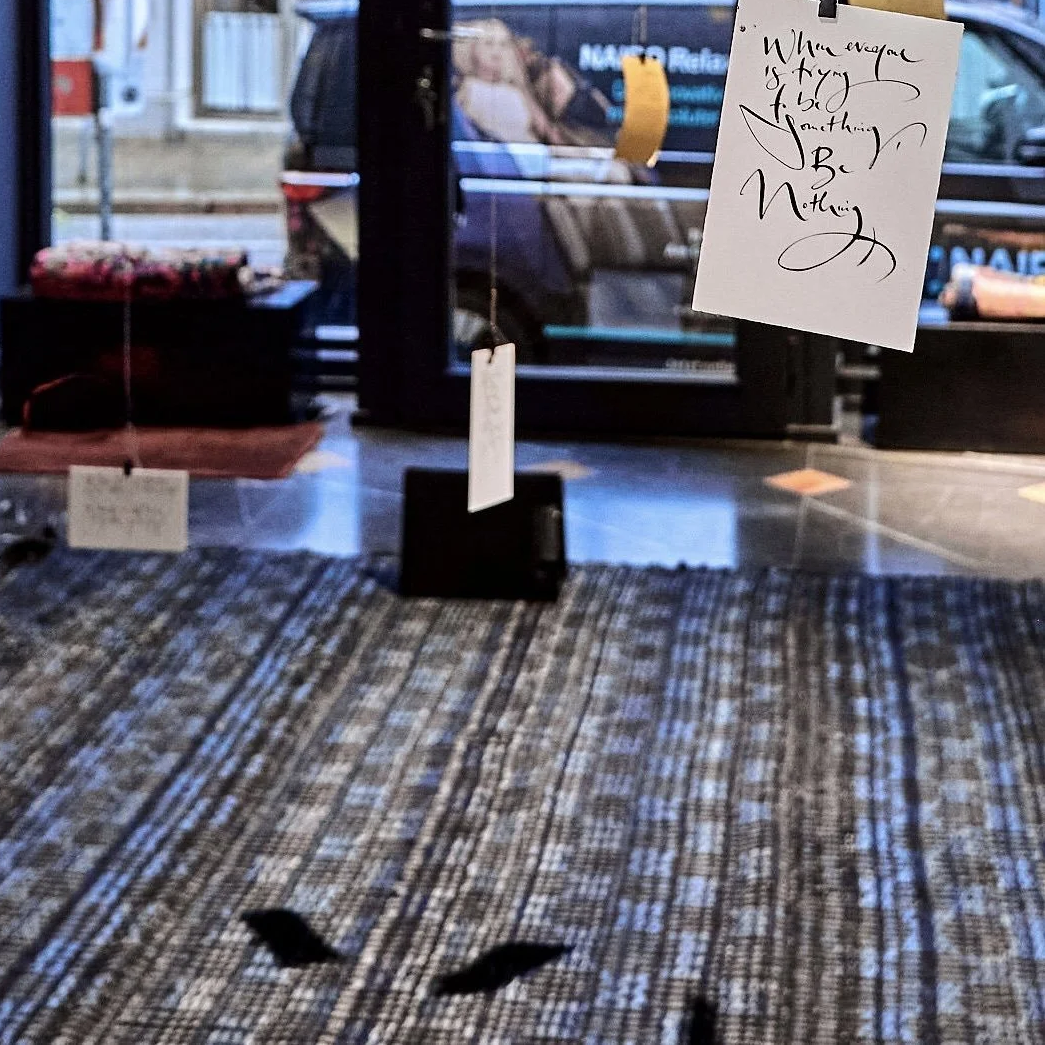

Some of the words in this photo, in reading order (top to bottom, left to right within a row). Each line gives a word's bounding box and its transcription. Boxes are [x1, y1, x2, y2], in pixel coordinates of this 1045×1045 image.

[764, 29, 843, 64] When
[765, 65, 788, 90] is
[770, 83, 787, 123] to
[797, 91, 821, 112] be
[811, 145, 855, 190] Be
